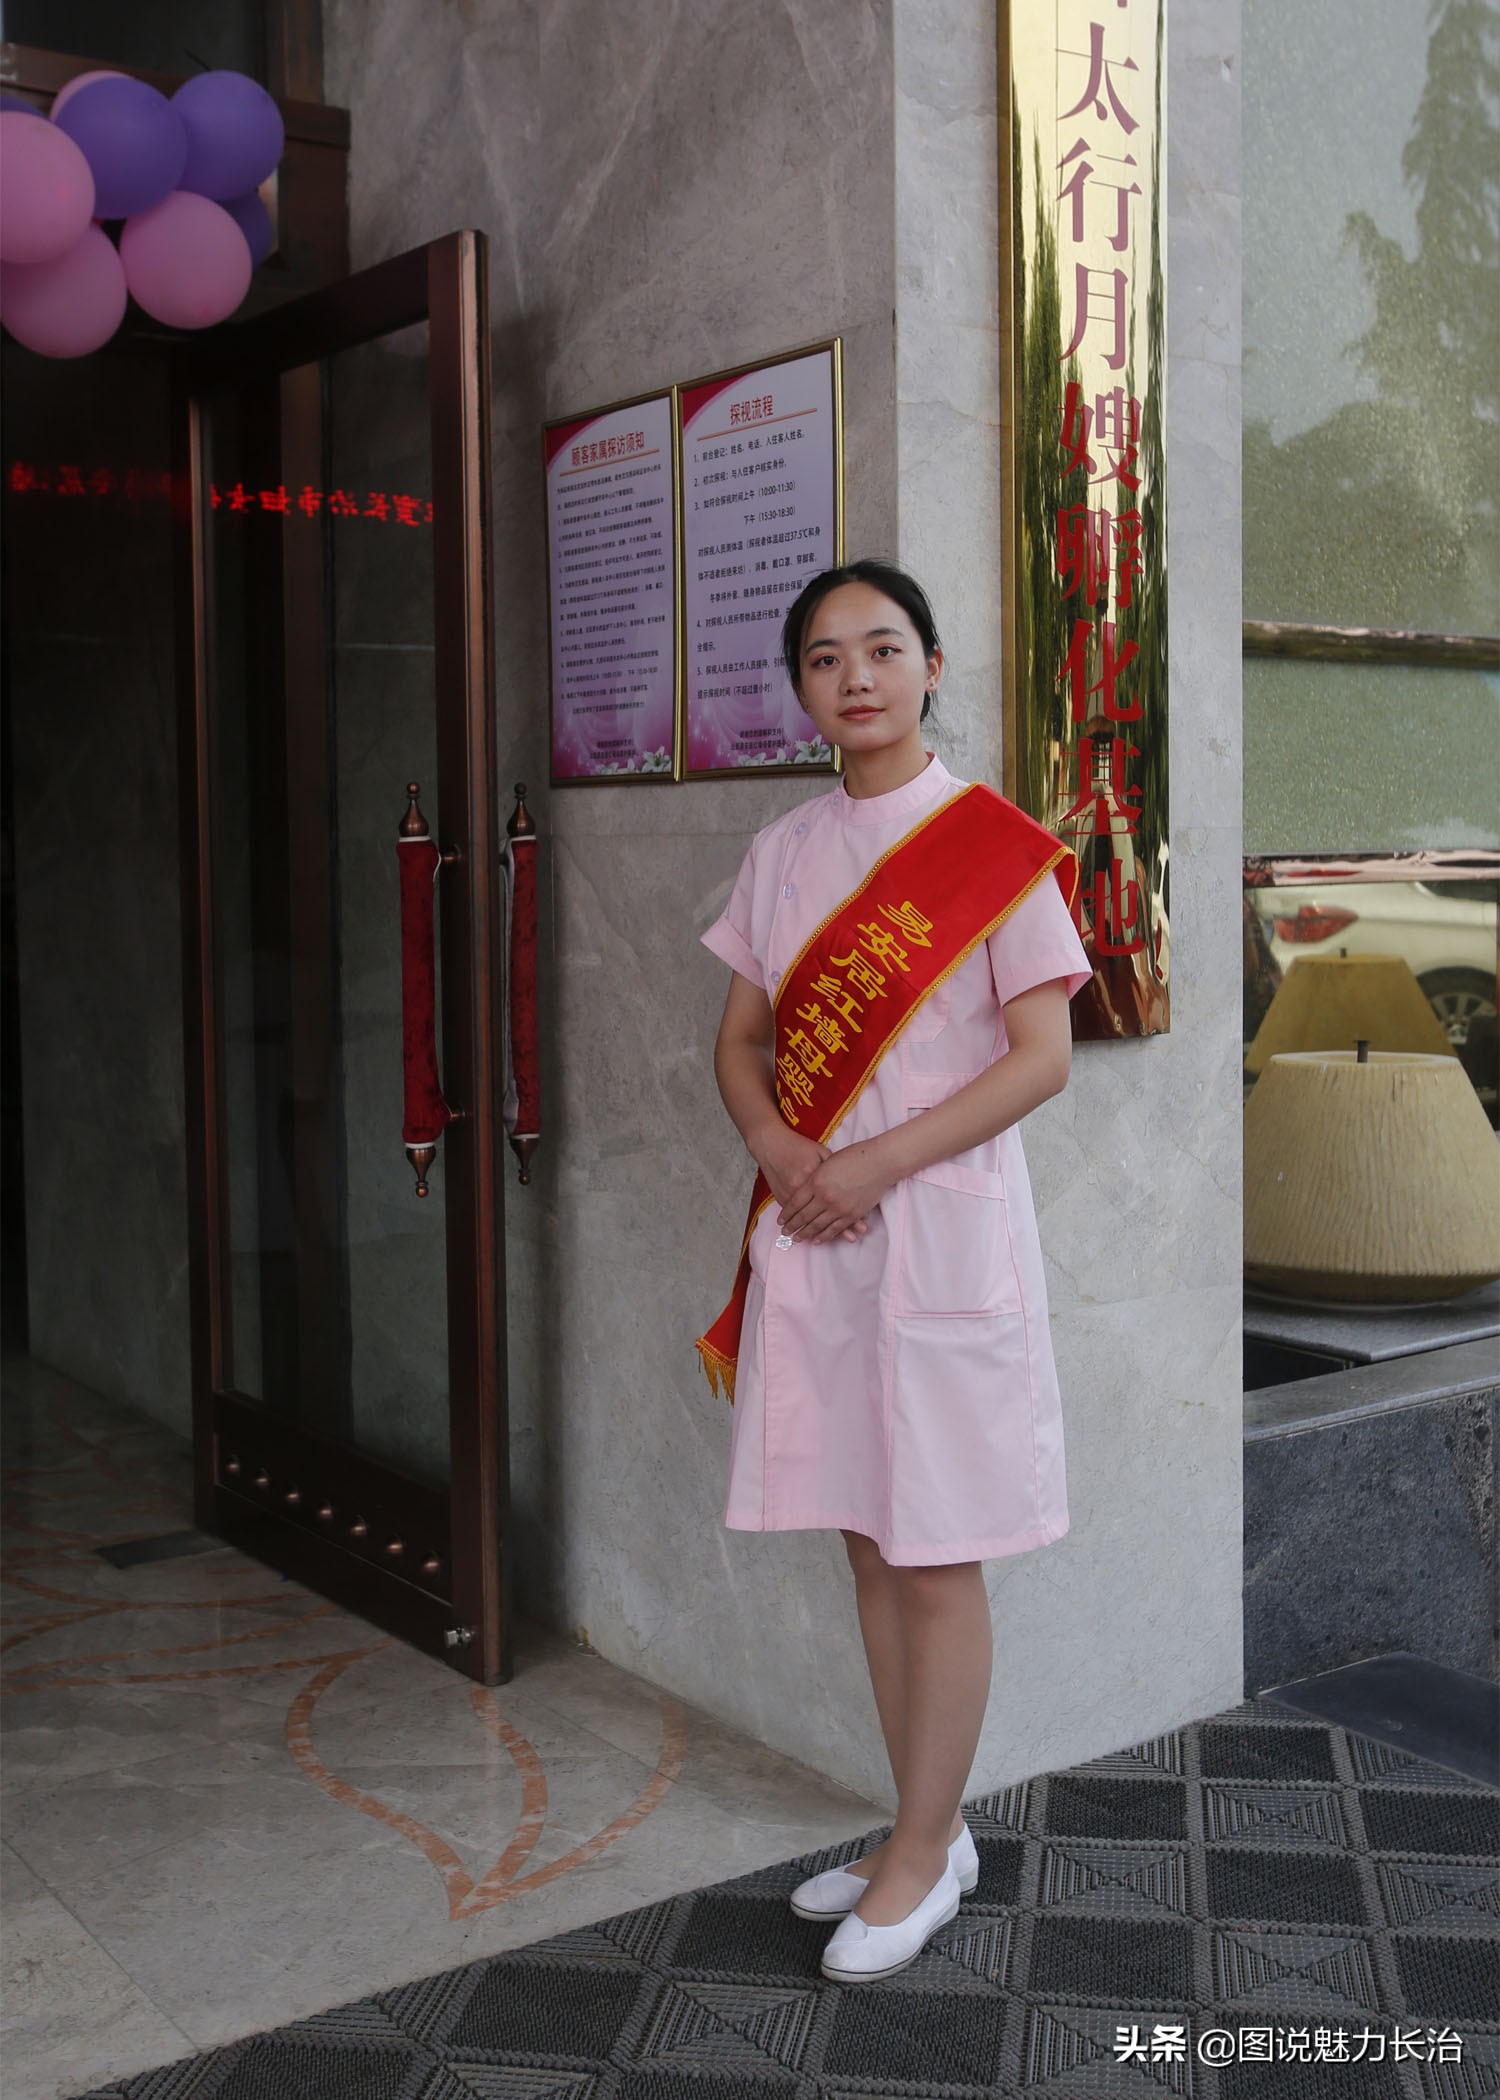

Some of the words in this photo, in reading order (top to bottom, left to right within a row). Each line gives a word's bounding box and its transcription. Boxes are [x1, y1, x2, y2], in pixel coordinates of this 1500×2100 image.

[730, 395, 774, 426] 探视流程
[571, 431, 645, 467] 顾客家属探访须知
[1057, 0, 1144, 956] 太行月嫂孵化基地
